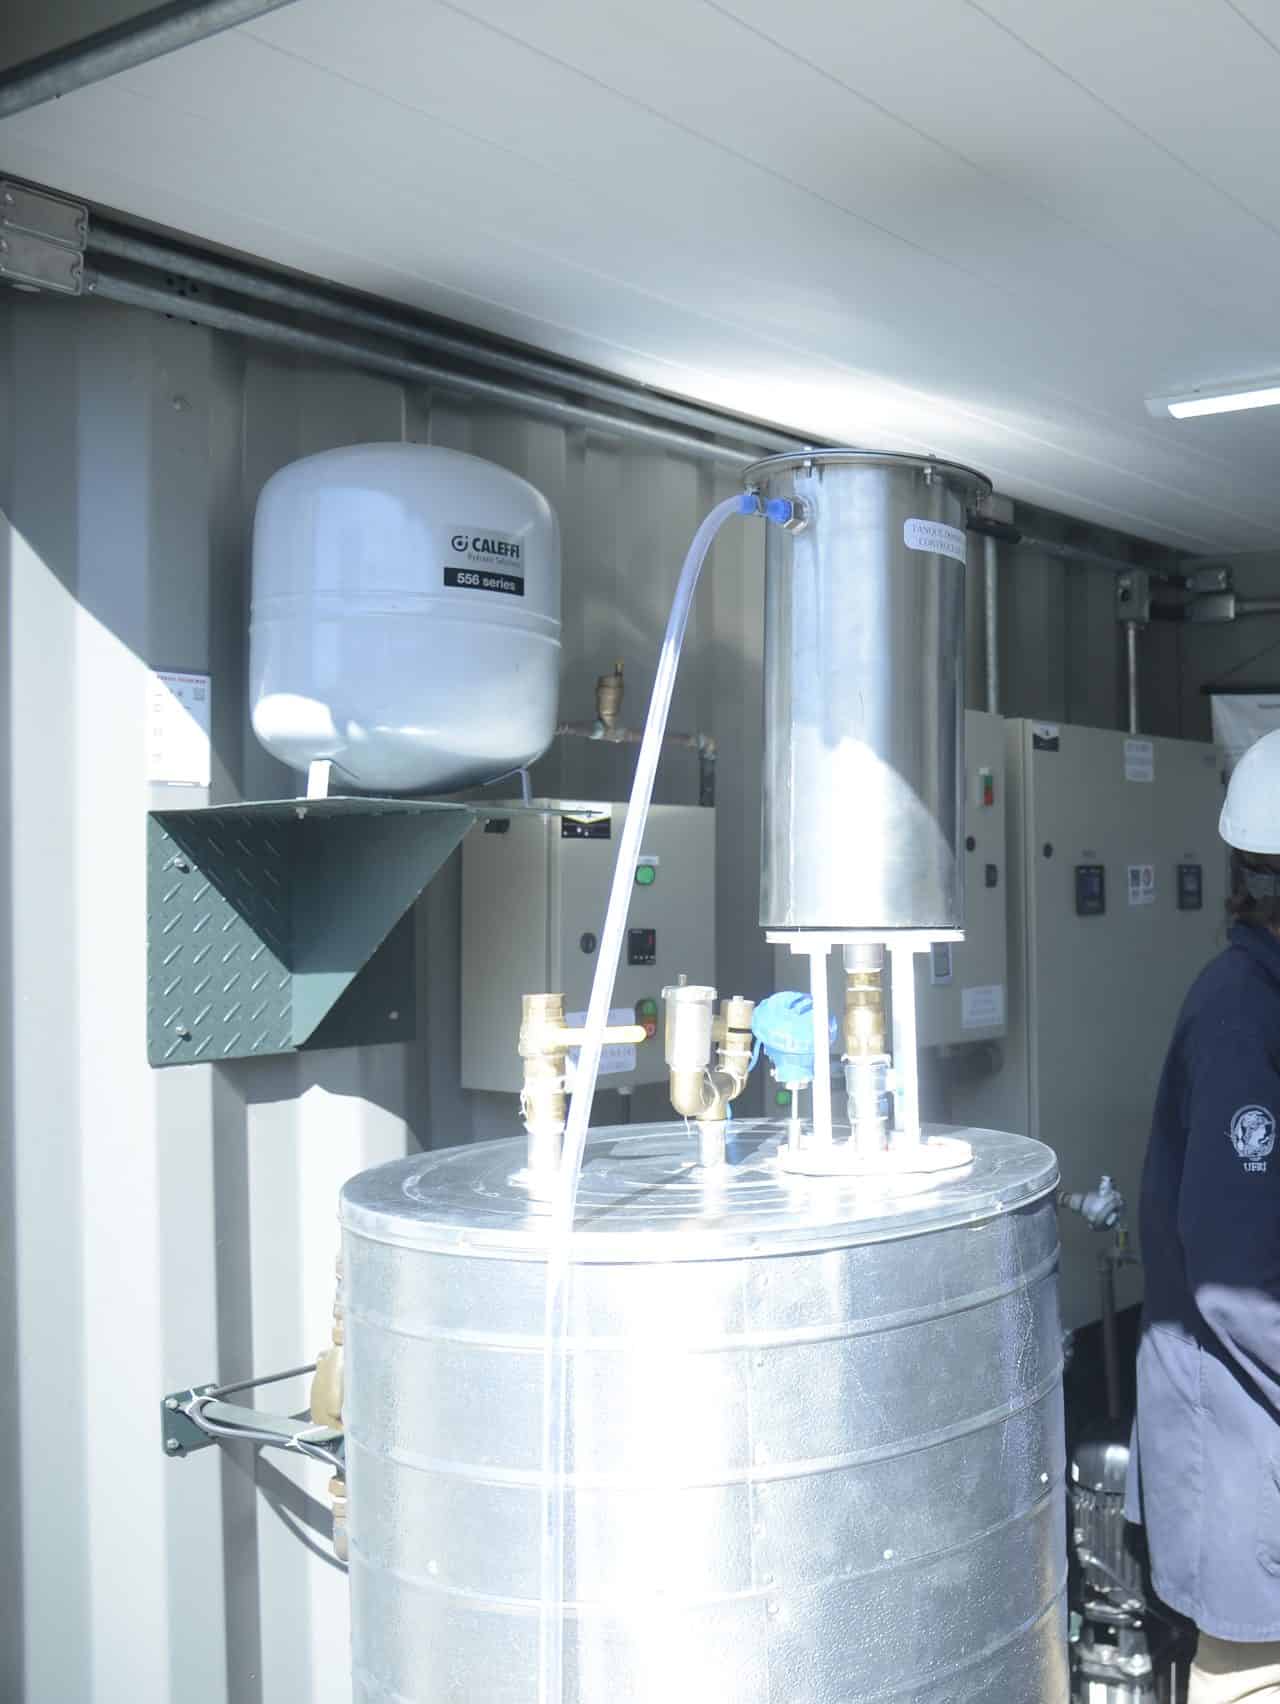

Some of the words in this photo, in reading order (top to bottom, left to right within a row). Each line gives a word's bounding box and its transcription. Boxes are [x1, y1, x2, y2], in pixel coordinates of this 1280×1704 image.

[472, 537, 520, 558] CALEFFI
[457, 572, 480, 585] 556
[482, 577, 516, 591] series
